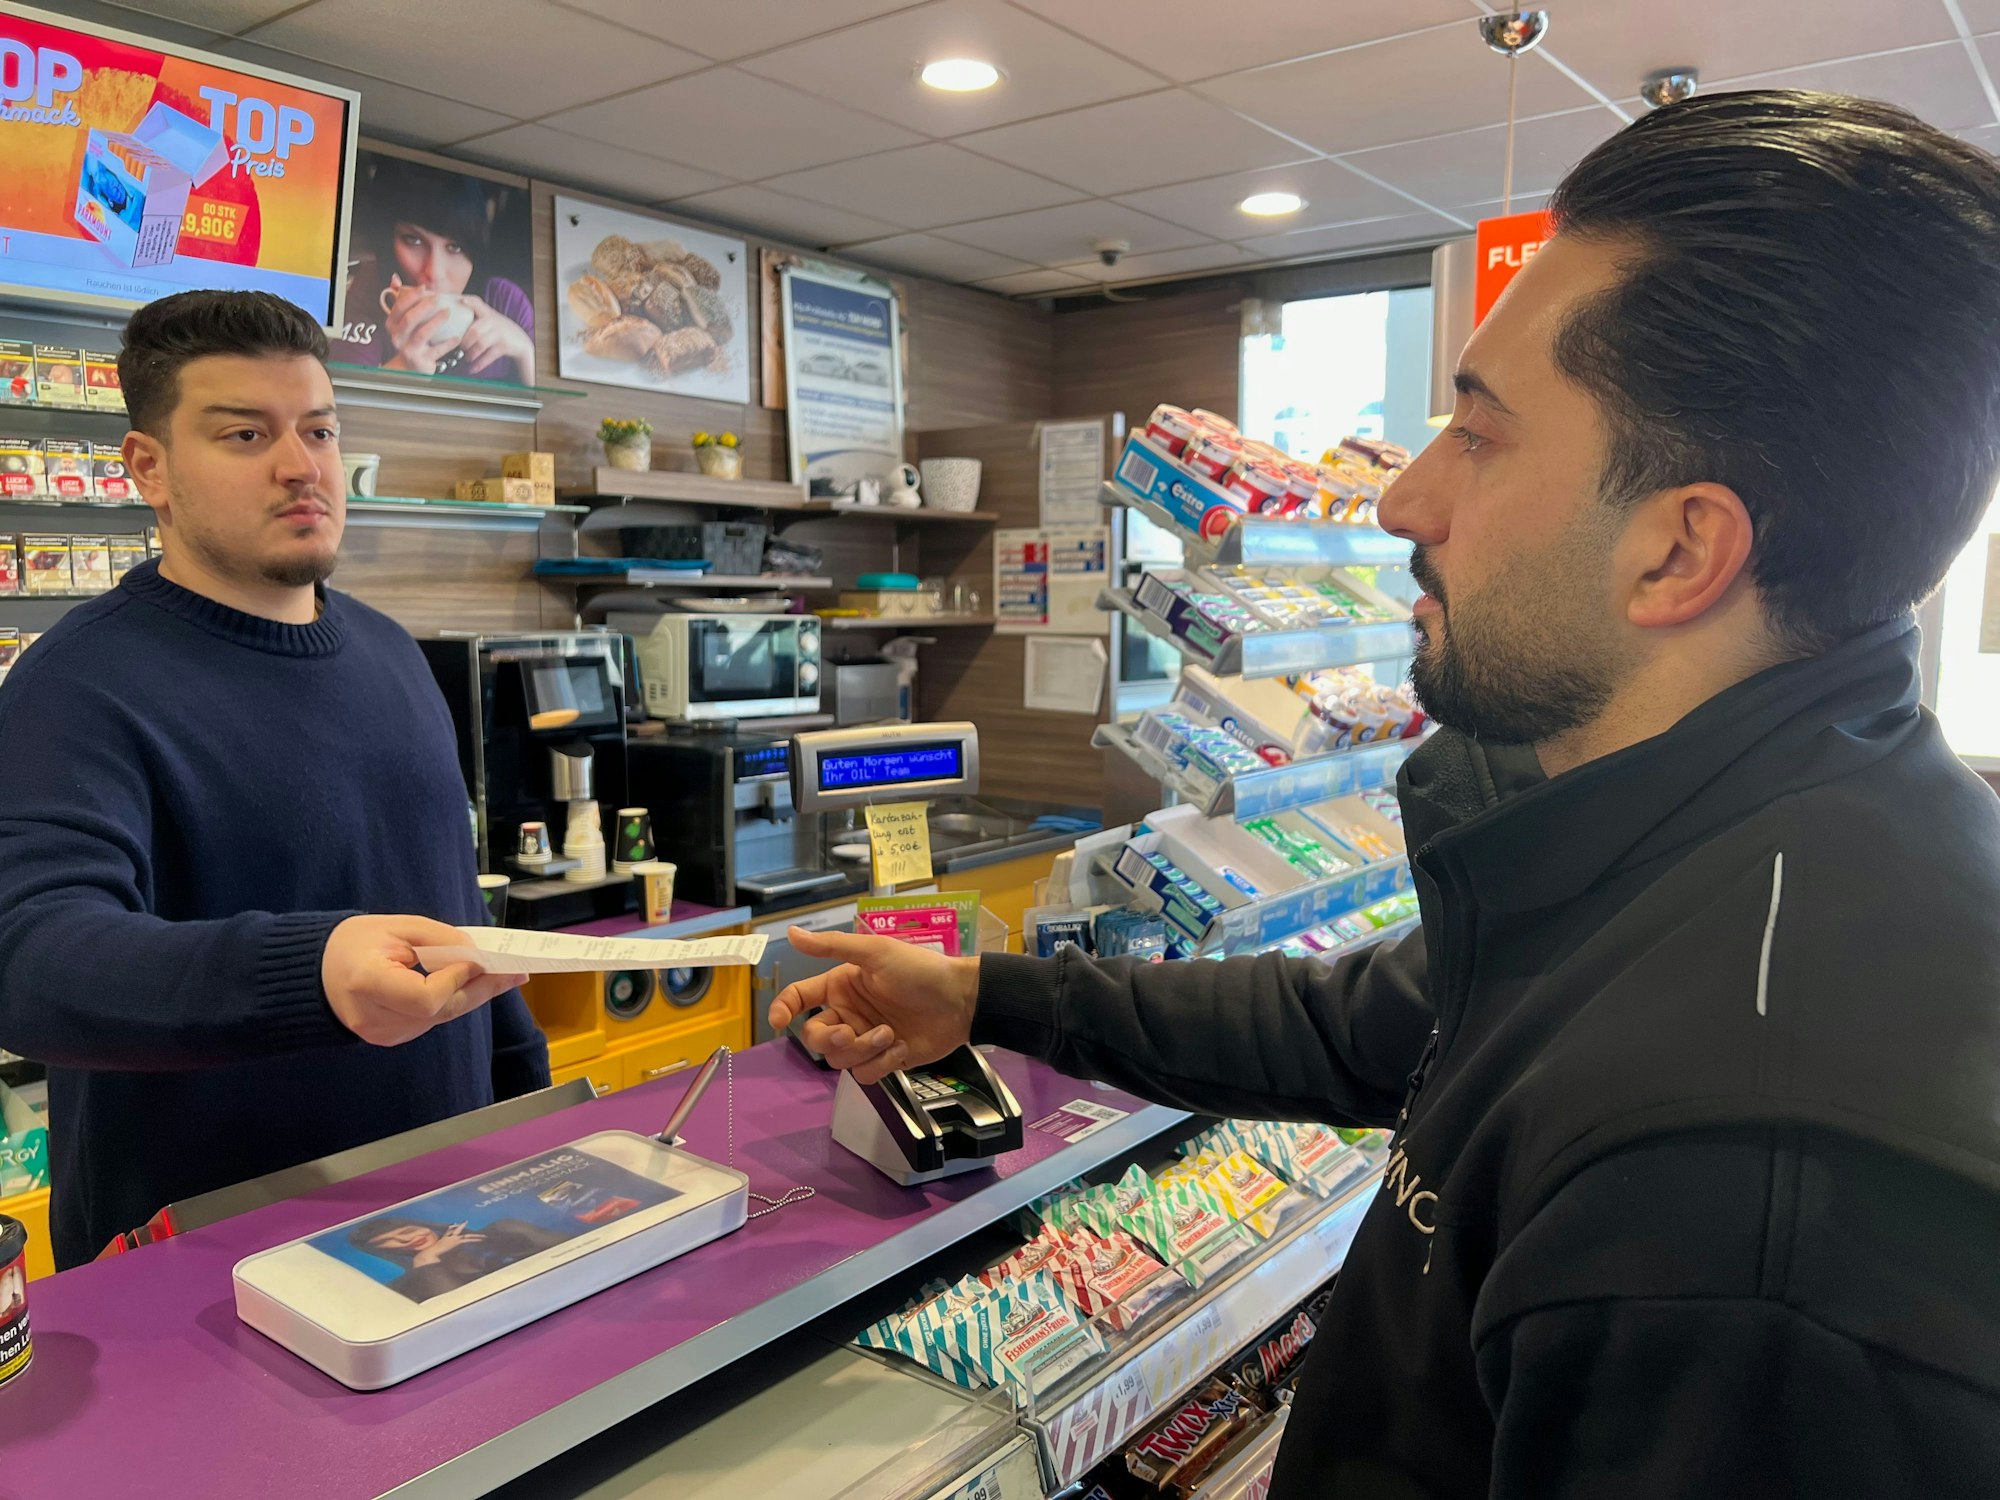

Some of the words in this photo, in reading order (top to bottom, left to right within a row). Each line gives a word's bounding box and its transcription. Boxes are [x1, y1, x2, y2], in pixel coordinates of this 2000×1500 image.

[199, 86, 315, 160] TOP
[230, 144, 286, 180] Preis
[202, 202, 216, 216] 60
[217, 205, 237, 220] STK
[181, 212, 235, 240] 9,90€
[86, 278, 122, 292] Rauchen
[123, 282, 133, 292] ist
[61, 479, 80, 487] LUCKY
[1171, 481, 1206, 512] extra
[1223, 717, 1255, 747] extra
[823, 759, 858, 771] Guten
[863, 756, 904, 768] Morgen
[908, 750, 953, 763] wünscht
[824, 771, 845, 783] Ihr
[884, 765, 911, 777] Team
[872, 917, 887, 929] 10
[982, 1334, 990, 1349] OHNE
[1004, 1324, 1051, 1362] FISHERMAN'S
[1046, 1314, 1071, 1334] FRIEND
[1257, 1311, 1317, 1385] Mars
[1117, 1375, 1135, 1397] 1,99
[1136, 1400, 1215, 1468] TWIX
